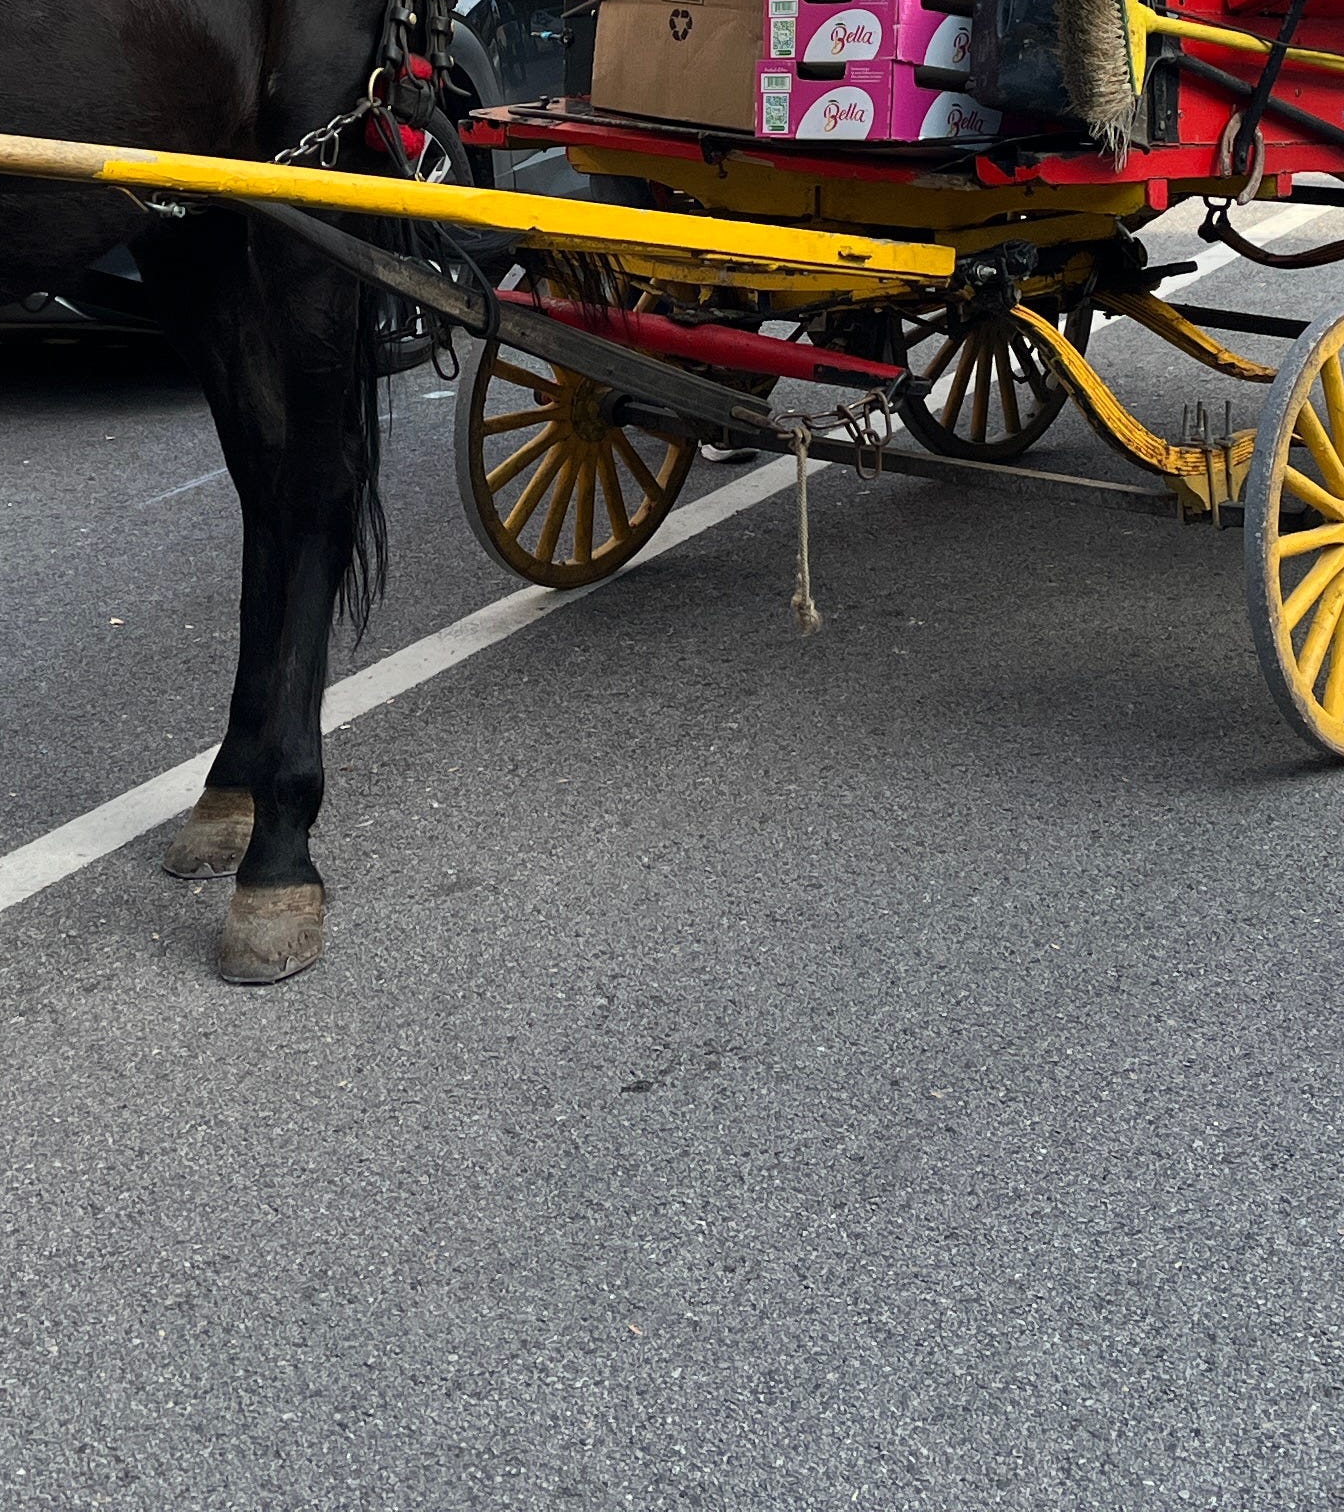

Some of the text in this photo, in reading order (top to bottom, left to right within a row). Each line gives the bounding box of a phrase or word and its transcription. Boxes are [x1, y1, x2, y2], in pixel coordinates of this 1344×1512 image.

[830, 24, 874, 56] Bella
[823, 101, 866, 133] Bella
[946, 106, 985, 137] Bella
